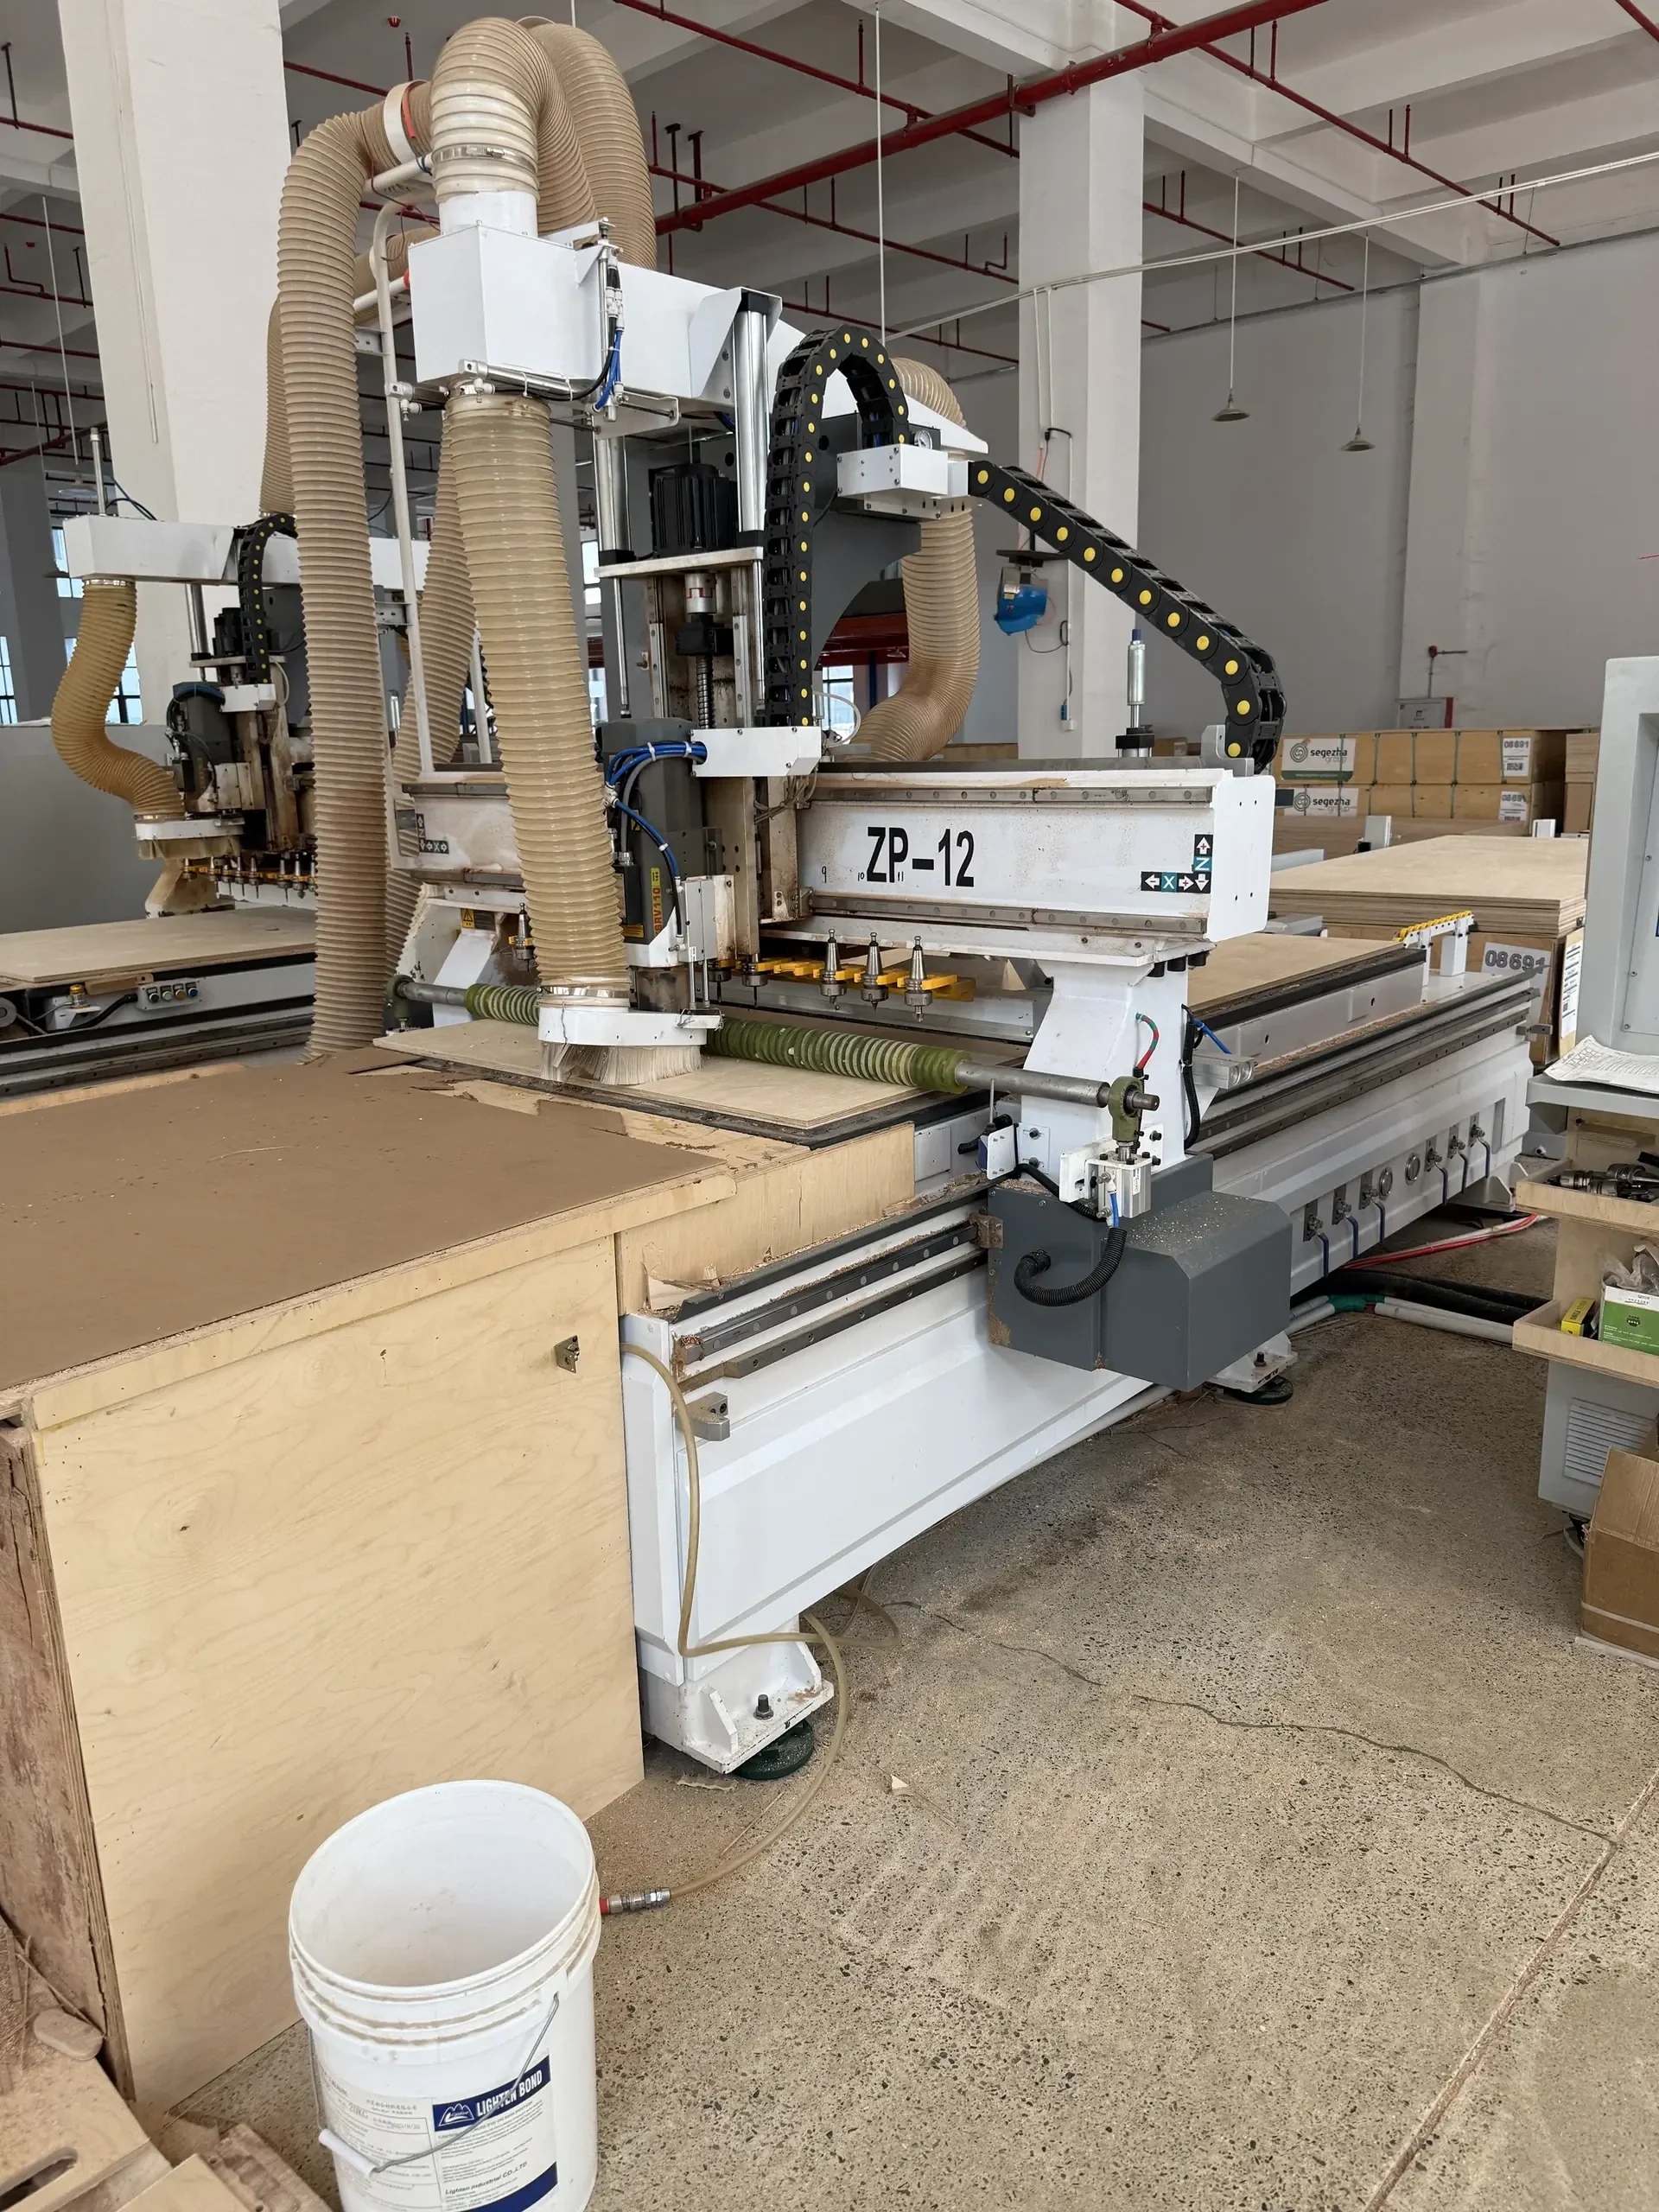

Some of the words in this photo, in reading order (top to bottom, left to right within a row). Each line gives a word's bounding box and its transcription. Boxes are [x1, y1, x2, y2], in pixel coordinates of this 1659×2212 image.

[1310, 747, 1348, 758] segezha
[1313, 797, 1351, 807] segezha
[867, 826, 975, 887] ZP-12
[1484, 950, 1545, 974] 08691
[475, 2087, 518, 2117] LIGHTEN
[518, 2069, 543, 2098] BOND
[445, 2185, 470, 2195] Lighten
